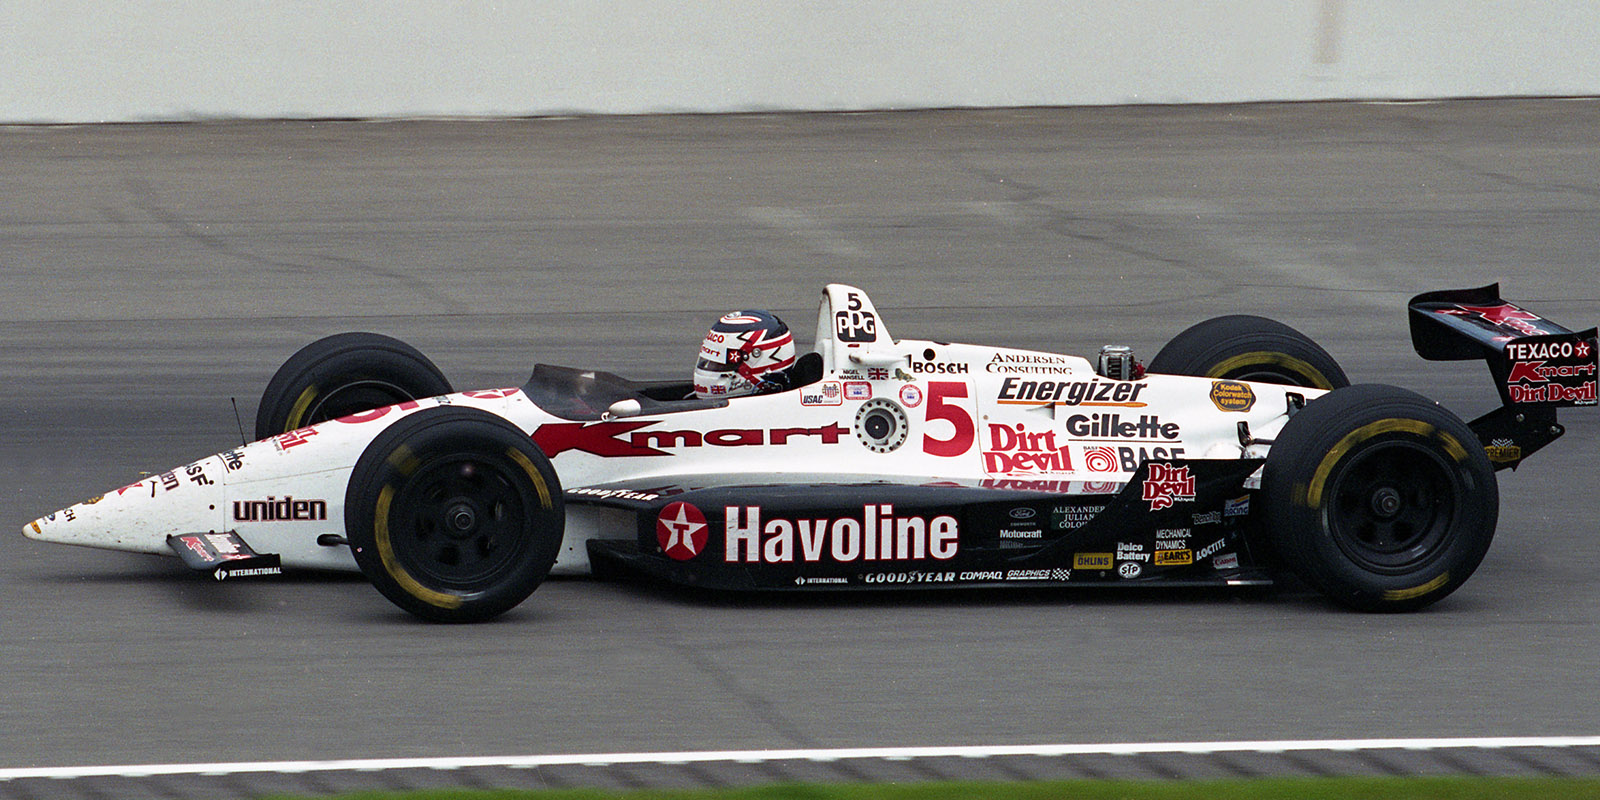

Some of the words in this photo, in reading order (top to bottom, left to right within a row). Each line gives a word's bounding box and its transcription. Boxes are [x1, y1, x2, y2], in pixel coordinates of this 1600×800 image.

[848, 293, 862, 311] 5
[837, 313, 875, 338] PPG
[1506, 342, 1573, 360] TEXACO
[991, 352, 1066, 364] ANDERSEN
[913, 361, 969, 374] BOSCH
[1507, 360, 1596, 383] Kmart
[997, 377, 1148, 406] Energizer
[1220, 383, 1242, 391] Kodak
[1508, 383, 1547, 403] Dirt
[1548, 381, 1597, 402] Devil
[803, 394, 824, 404] USAC
[1220, 398, 1246, 406] system
[922, 381, 976, 457] 5
[1066, 413, 1180, 439] Gillette
[530, 420, 851, 459] Kmart
[988, 423, 1056, 452] Dirt
[983, 444, 1076, 474] Devil
[1148, 462, 1190, 481] Dirt
[1142, 476, 1196, 502] Devil
[232, 495, 327, 522] uniden
[1064, 513, 1095, 522] JULIAN
[724, 503, 960, 564] Havoline
[1000, 529, 1043, 538] Motorcraft
[1156, 528, 1192, 539] MECHANICAL
[1117, 542, 1143, 552] Delco
[1155, 539, 1187, 550] DYNAMICS
[1196, 537, 1227, 561] LOCTITE
[1116, 551, 1151, 562] Battery
[1164, 550, 1191, 561] EARL'S
[1214, 556, 1237, 566] Canon
[229, 567, 282, 577] INTERNATIONAL
[959, 571, 1003, 581] COMPAQ
[1007, 569, 1050, 578] GRAPHICS
[1121, 564, 1139, 575] STP
[864, 571, 956, 584] GOODYEAR
